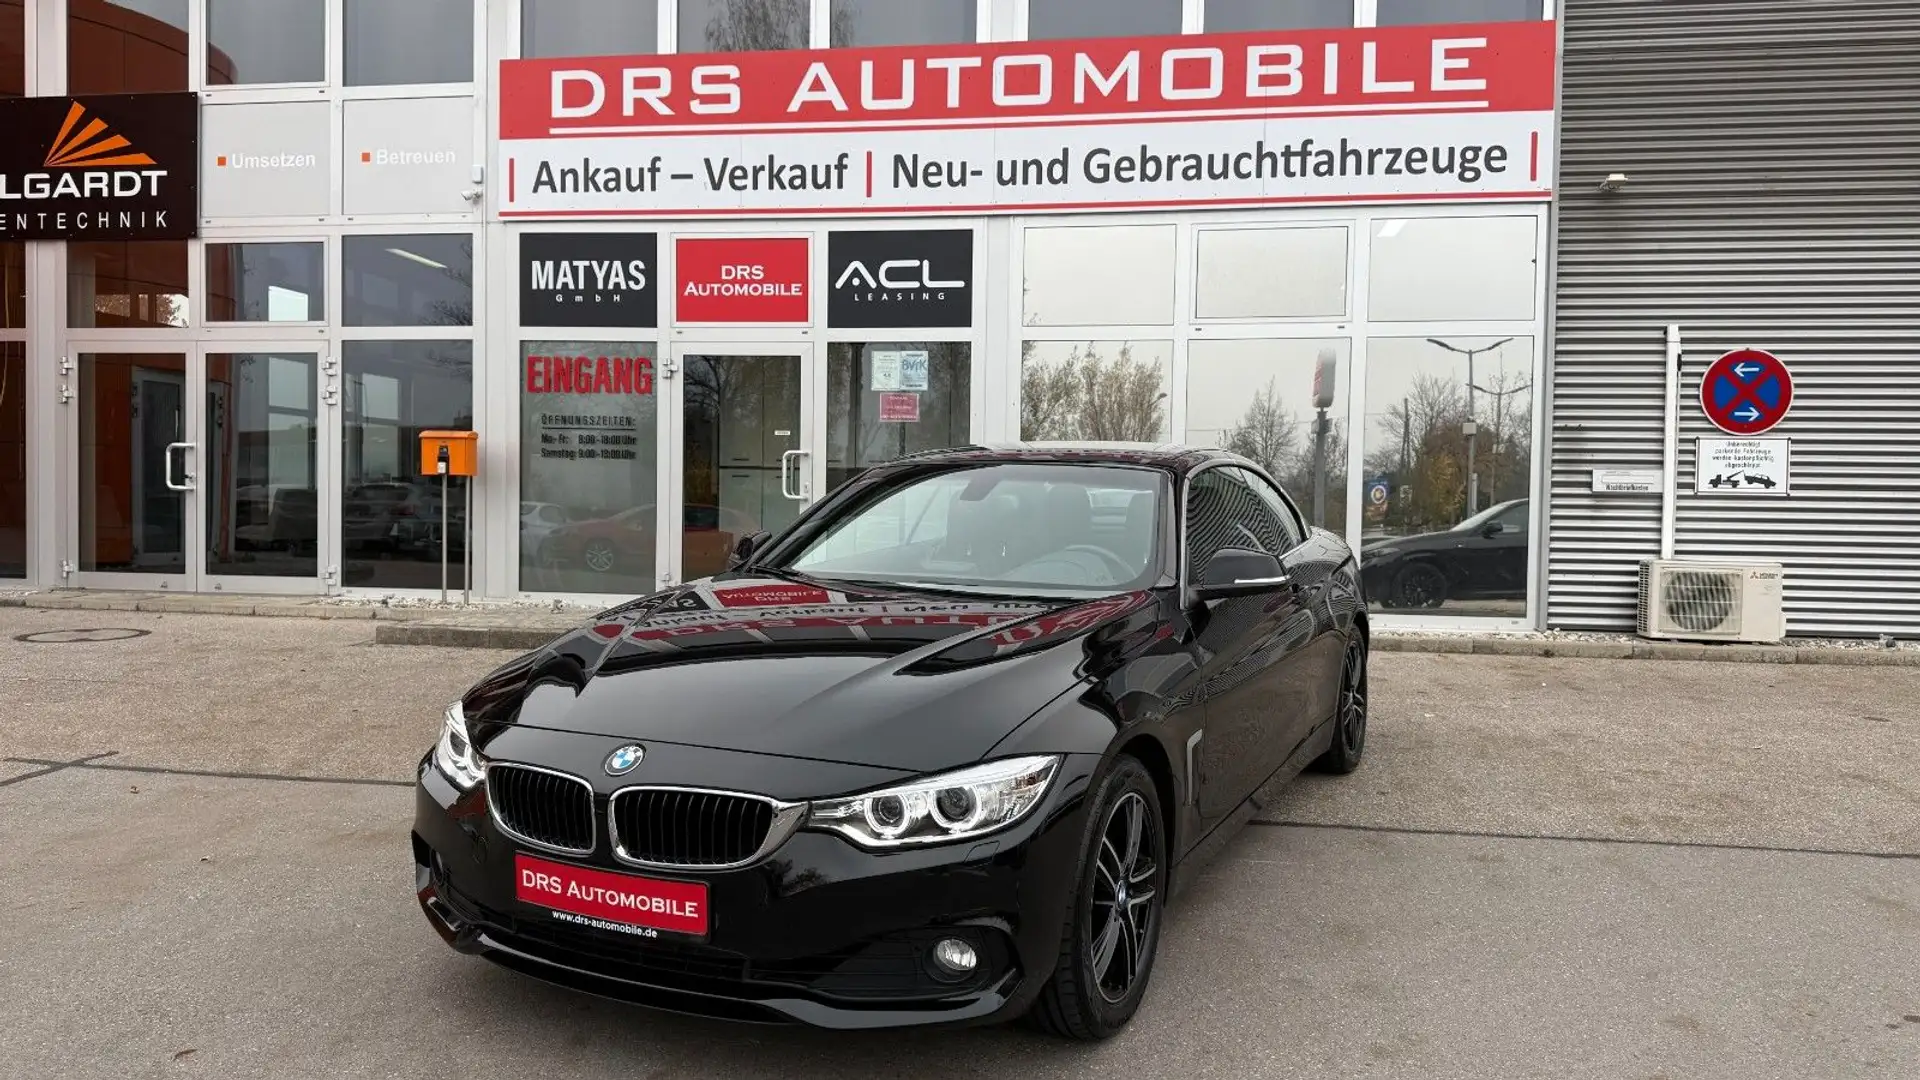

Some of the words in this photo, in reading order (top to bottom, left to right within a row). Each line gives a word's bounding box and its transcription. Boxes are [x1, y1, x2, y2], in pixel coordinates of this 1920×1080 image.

[550, 64, 741, 119] DRS
[786, 37, 1487, 113] AUTOMOBILE
[231, 151, 316, 170] Umsetzen
[375, 147, 456, 166] Betreuen
[532, 156, 662, 194] Ankauf
[703, 152, 849, 191] Verkauf
[892, 152, 983, 189] Neu-
[996, 147, 1070, 187] und
[1083, 137, 1508, 184] Gebrauchtfahrzeuge
[531, 260, 646, 291] MATYAS
[721, 265, 765, 280] DRS
[835, 259, 965, 289] ACL
[555, 293, 621, 303] GmbH
[683, 281, 803, 297] AUTOMOBILE
[854, 292, 945, 302] LEASING
[527, 355, 653, 395] EINGANG
[522, 868, 562, 894] DRS
[566, 880, 699, 918] AUTOMOBILE
[551, 909, 658, 939] www.drs-automobile.de
